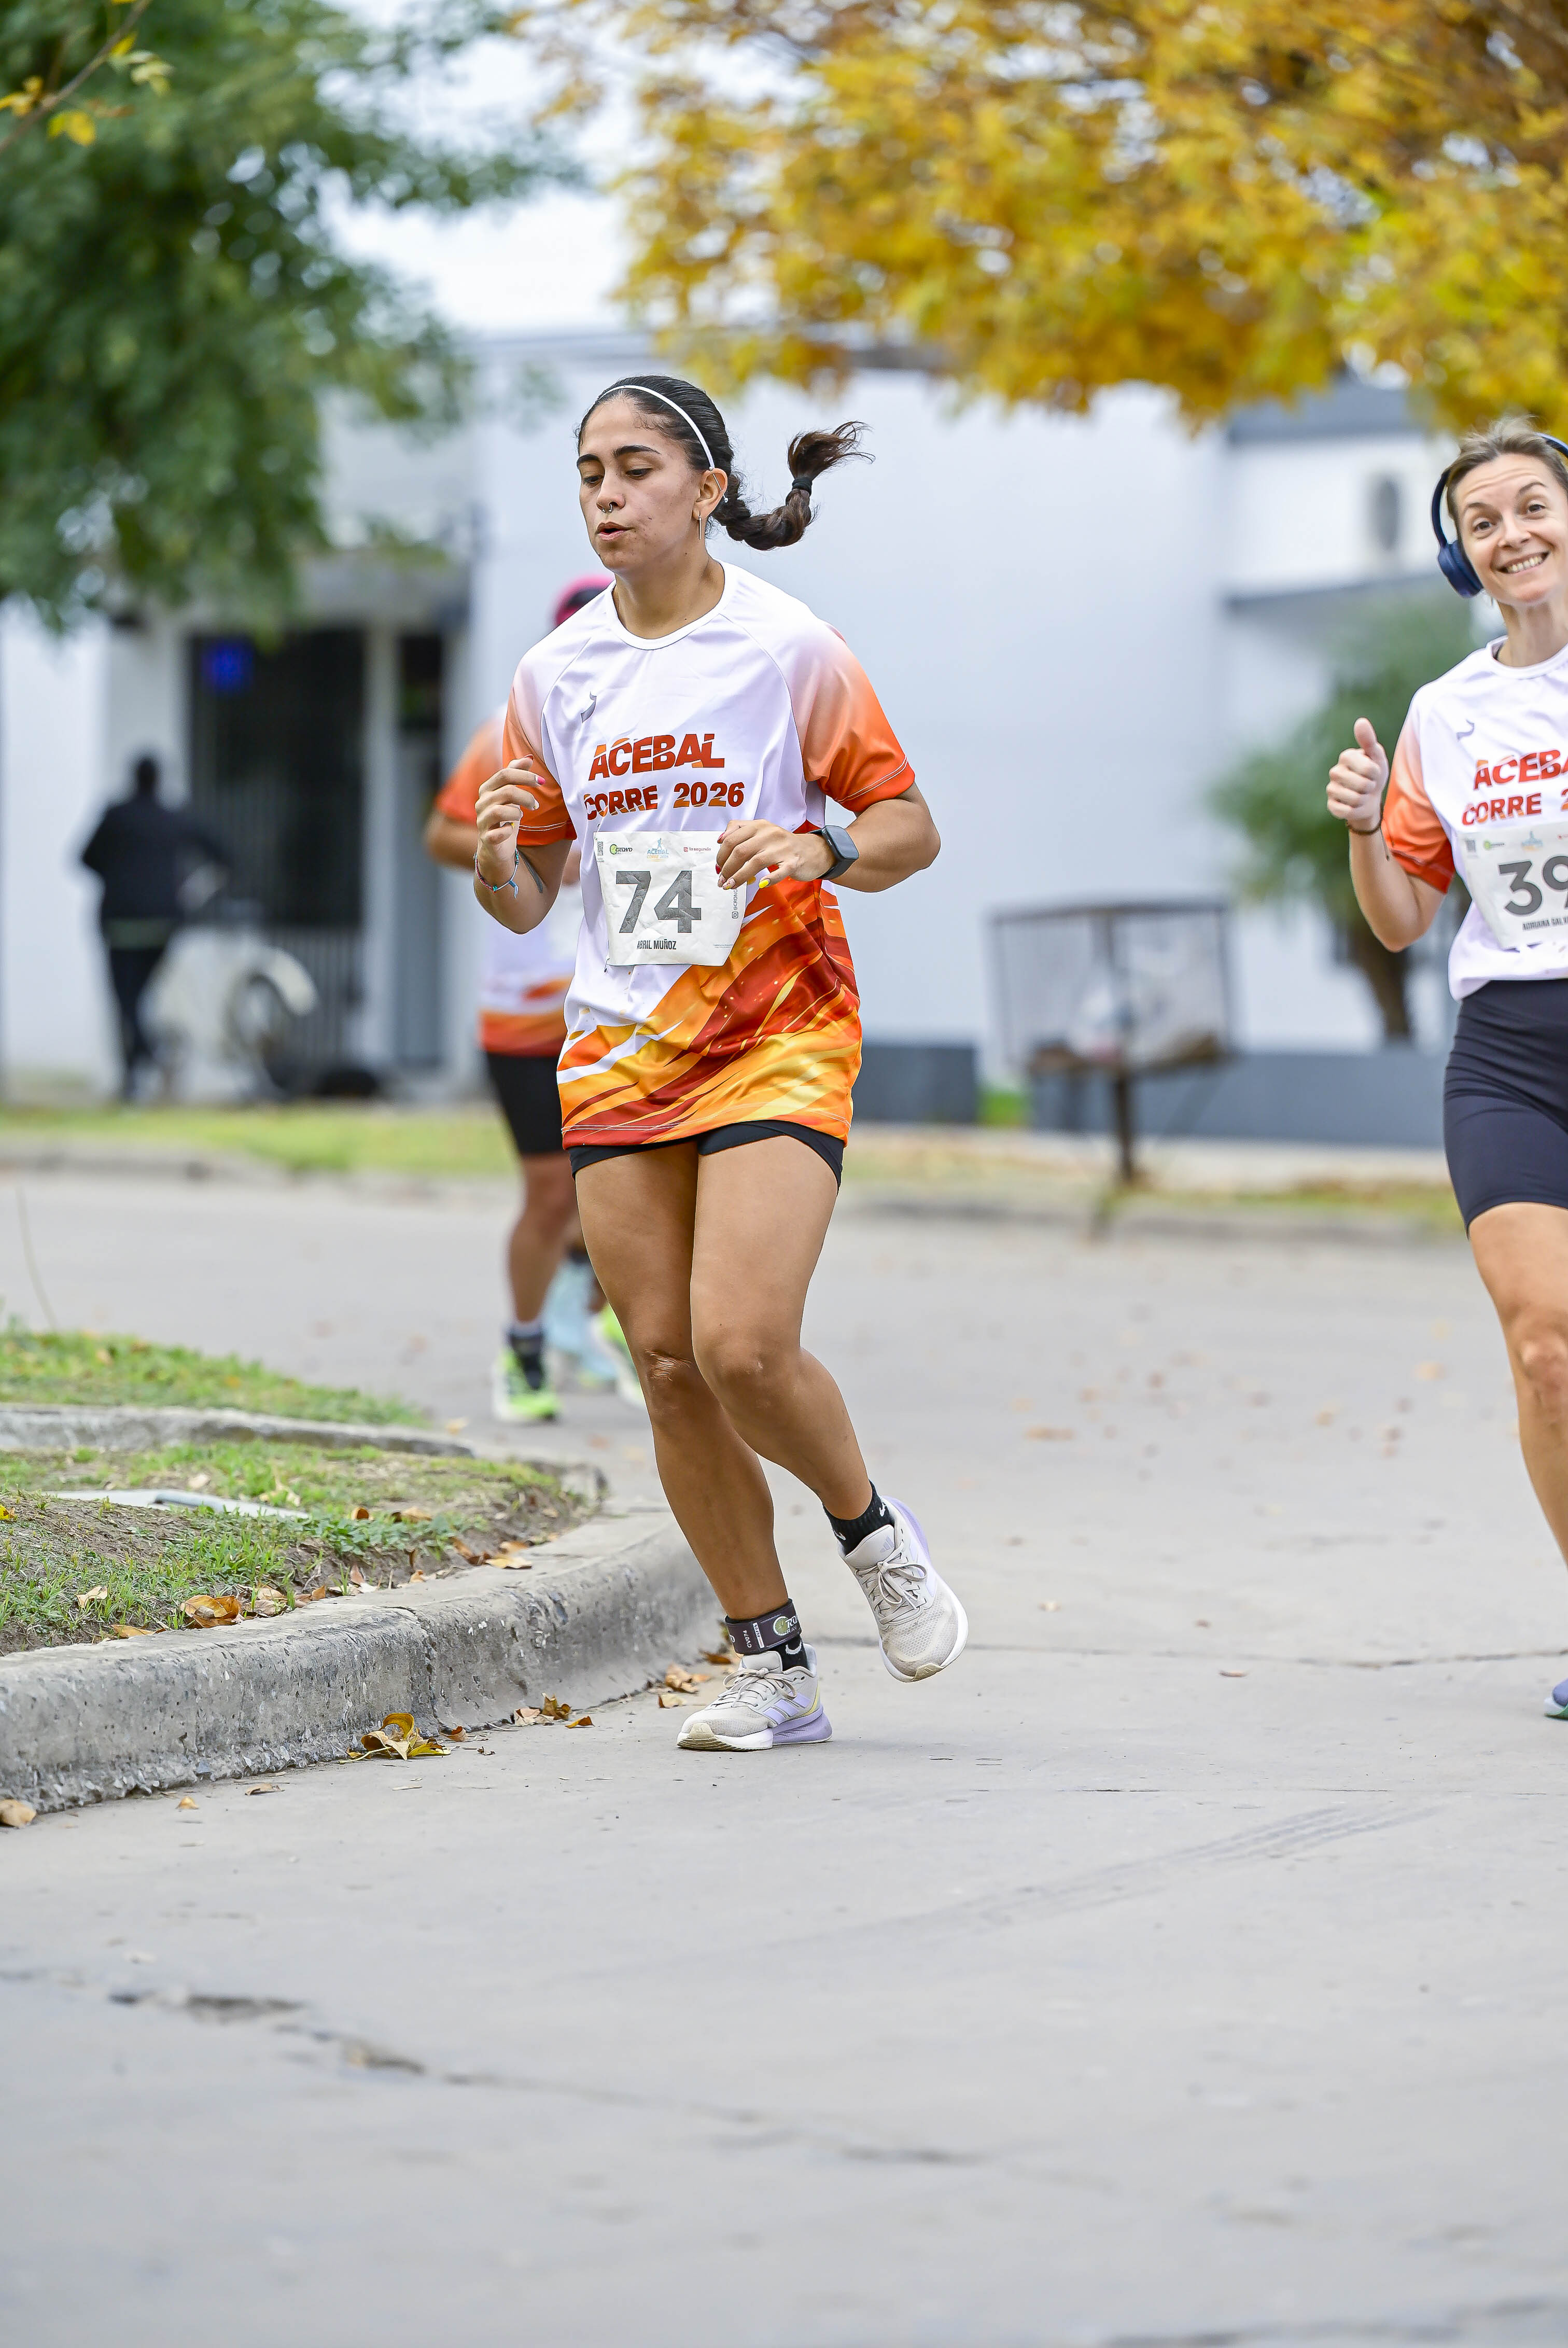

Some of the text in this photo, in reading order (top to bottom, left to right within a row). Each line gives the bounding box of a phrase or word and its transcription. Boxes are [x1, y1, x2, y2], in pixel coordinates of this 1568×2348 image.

[589, 733, 725, 781] ACEBAL
[583, 781, 745, 820] CORRE 2026
[1462, 792, 1542, 826] CORRE
[616, 870, 702, 933] 74
[637, 939, 677, 950] ABRIL MUÑOZ
[743, 1630, 752, 1648] CV074
